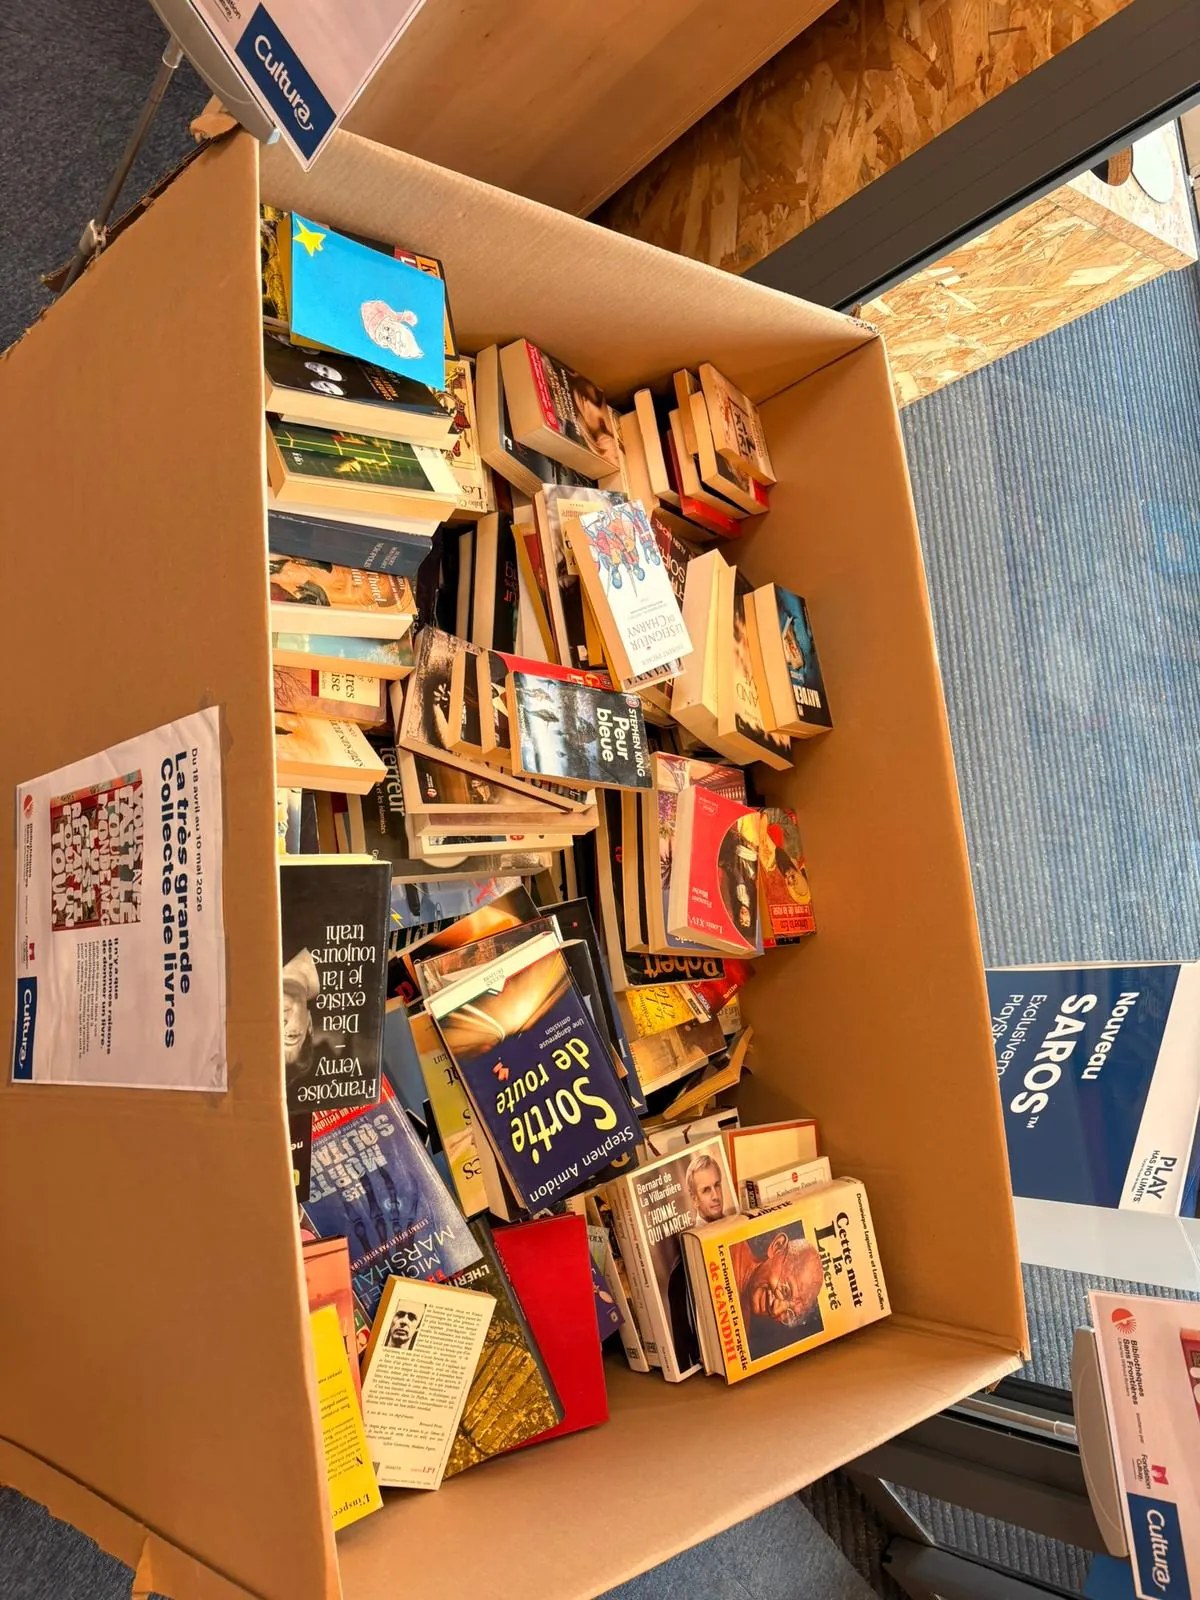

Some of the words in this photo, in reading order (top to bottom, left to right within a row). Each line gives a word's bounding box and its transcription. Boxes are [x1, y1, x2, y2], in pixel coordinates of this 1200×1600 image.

[255, 35, 313, 129] Cultura
[597, 707, 614, 763] bleue
[612, 717, 630, 761] Peur
[628, 708, 642, 750] STEPHEN
[635, 751, 646, 778] KING
[175, 751, 187, 790] La
[191, 748, 197, 765] Du
[192, 769, 198, 782] 18
[97, 793, 110, 883] MONDE
[107, 788, 119, 869] TOUR
[119, 785, 133, 869] FAIT
[161, 758, 173, 895] Collecte
[176, 798, 190, 864] très
[194, 816, 200, 831] au
[195, 835, 201, 849] 10
[64, 887, 74, 927] UN
[100, 884, 110, 926] AVEC
[109, 877, 120, 923] DU
[114, 937, 118, 945] Il
[161, 903, 174, 945] de
[174, 872, 192, 994] grande
[326, 924, 364, 945] trahi
[102, 939, 106, 954] de
[311, 946, 376, 967] toujours
[322, 970, 344, 991] l'ai
[349, 965, 363, 988] je
[101, 1001, 105, 1016] un
[163, 952, 177, 1048] livres
[316, 991, 366, 1010] existe
[18, 988, 32, 1068] Cultura
[323, 1013, 360, 1034] Dieu
[538, 1024, 572, 1050] dangereuse
[545, 1016, 571, 1035] omission
[571, 1018, 585, 1029] Une
[996, 994, 1048, 1083] Exclusivem
[1081, 992, 1139, 1080] Nouveau
[315, 1057, 363, 1077] Verny
[552, 1038, 590, 1071] de
[298, 1078, 377, 1104] Françoise
[495, 1063, 550, 1114] route
[511, 1076, 617, 1165] Sortie
[582, 1126, 634, 1167] Stephen
[1149, 1150, 1160, 1164] HAS
[529, 1164, 579, 1204] Amidon
[636, 1176, 664, 1195] Bernard
[662, 1172, 672, 1182] de
[1144, 1165, 1153, 1176] NO
[1146, 1157, 1177, 1199] PLAY
[639, 1196, 649, 1208] La
[648, 1183, 682, 1206] Villardière
[856, 1193, 869, 1232] Dominique
[643, 1201, 677, 1228] L'HOMME
[647, 1226, 663, 1246] QUI
[663, 1211, 692, 1238] MARCHE
[717, 1244, 724, 1254] Le
[864, 1227, 875, 1258] Lapierre
[709, 1260, 719, 1283] de
[720, 1255, 734, 1299] triomphe
[814, 1221, 842, 1311] Liberté
[833, 1256, 842, 1276] la
[836, 1212, 853, 1265] Cette
[847, 1267, 863, 1309] nuit
[870, 1259, 876, 1267] et
[872, 1268, 880, 1289] Larry
[730, 1300, 736, 1310] et
[733, 1312, 739, 1322] la
[876, 1288, 885, 1311] Collins
[711, 1284, 738, 1363] GANDHI
[734, 1322, 748, 1371] tragédie
[1123, 1338, 1131, 1359] Sans
[1127, 1361, 1138, 1405] Frontières
[1131, 1340, 1144, 1397] Bibliothèques
[1142, 1454, 1151, 1489] Fondation
[331, 1493, 371, 1517] L'inspec
[1147, 1509, 1170, 1591] Cultura
